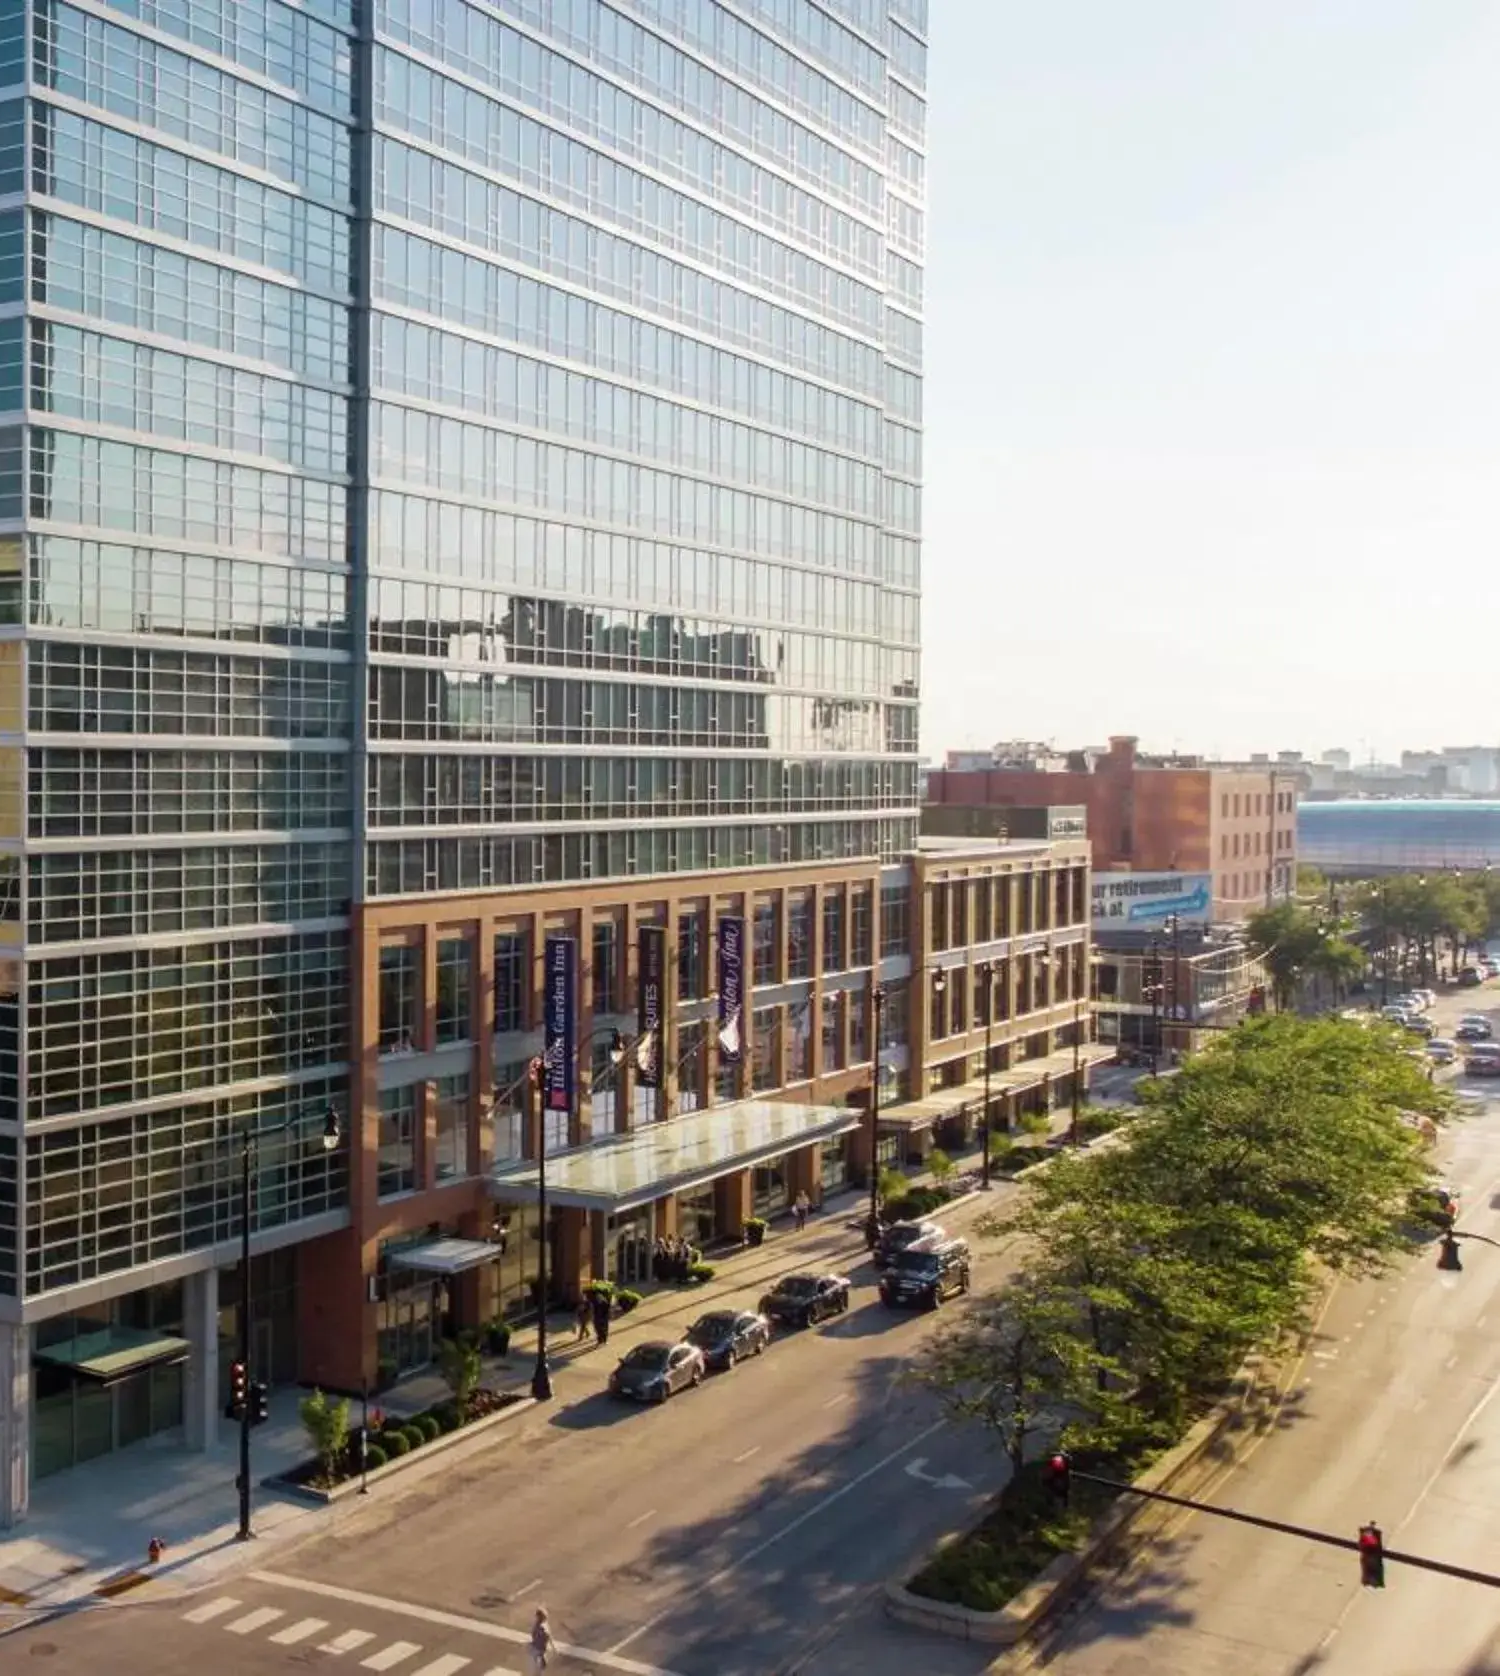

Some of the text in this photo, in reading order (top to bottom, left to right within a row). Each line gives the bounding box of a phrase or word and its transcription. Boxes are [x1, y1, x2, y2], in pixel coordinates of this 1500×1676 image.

[1109, 878, 1183, 897] retirement
[553, 943, 565, 972] Inn
[721, 923, 741, 968] Inn
[552, 975, 565, 1034] Garden
